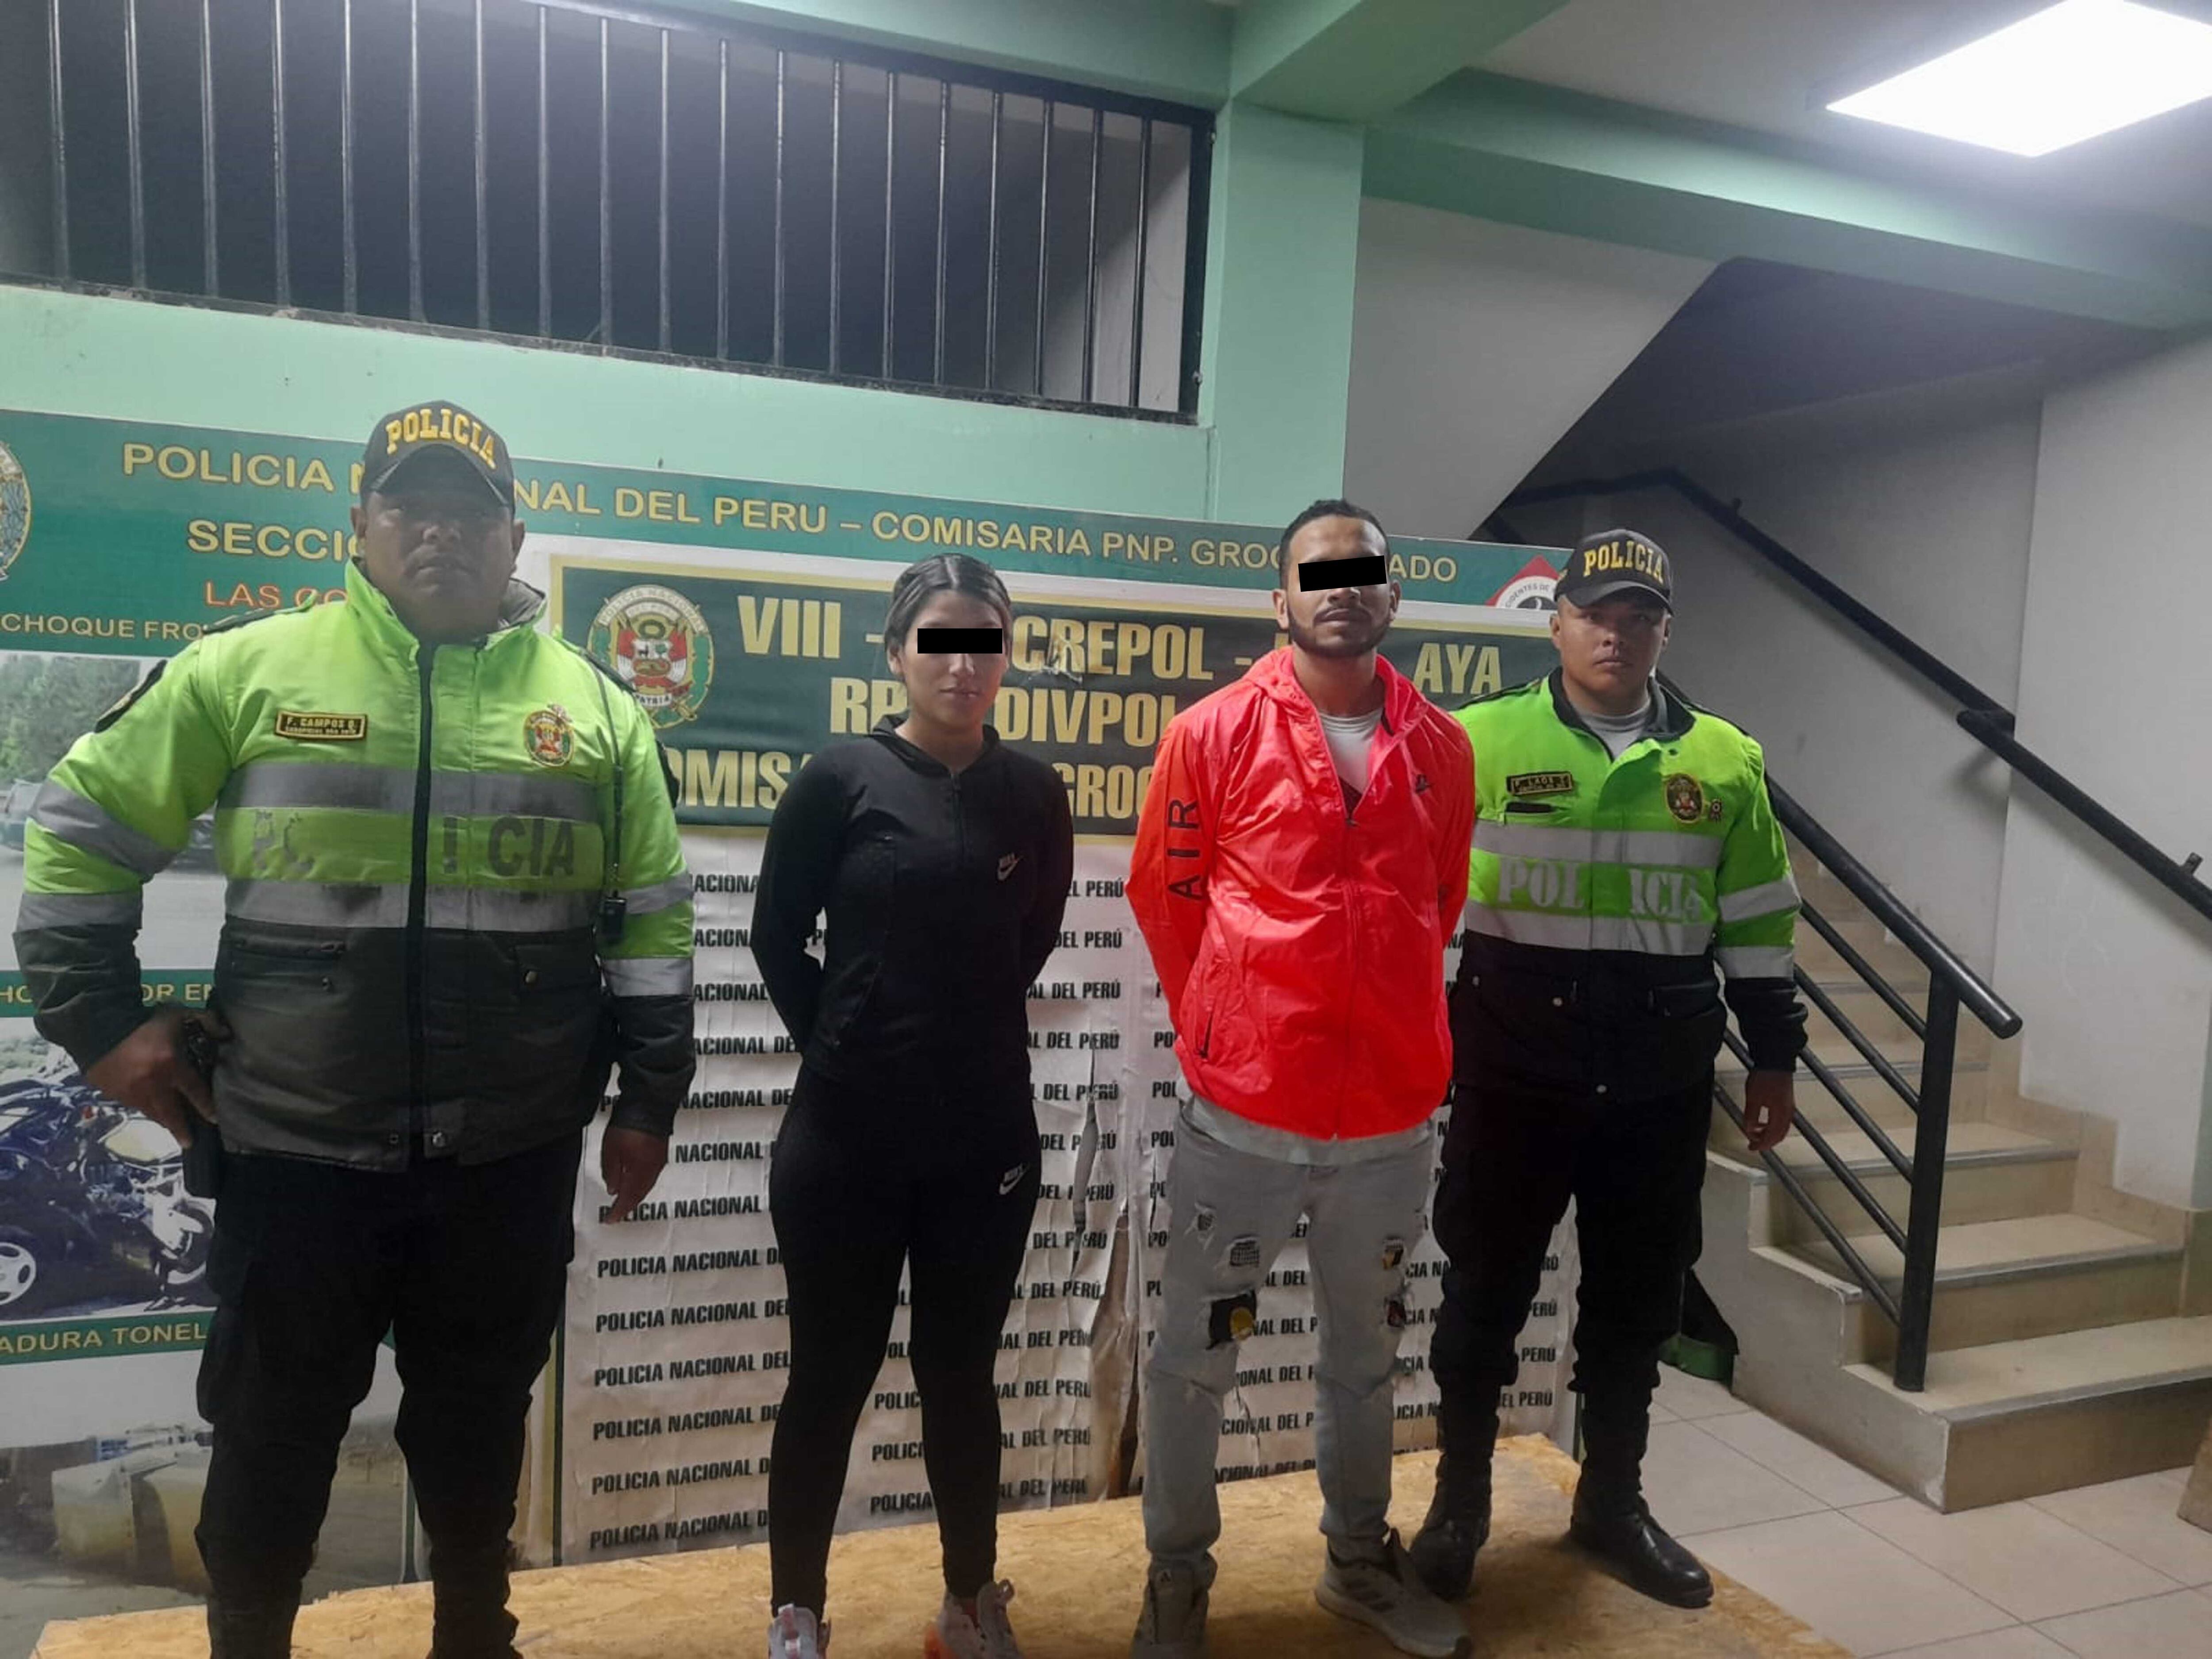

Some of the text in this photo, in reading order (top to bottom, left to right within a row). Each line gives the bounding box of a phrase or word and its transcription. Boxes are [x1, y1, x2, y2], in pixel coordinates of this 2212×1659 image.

[386, 408, 497, 470] POLICIA
[123, 443, 335, 492] POLICIA
[615, 488, 701, 524] DEL
[714, 496, 827, 534] PERU
[872, 511, 1091, 557] COMISARIA
[1102, 533, 1179, 564] PNP.
[1583, 541, 1665, 586] POLICIA
[205, 581, 281, 609] LAS
[1, 613, 135, 638] CHOQUE
[737, 595, 841, 658] VIII
[1166, 799, 1207, 901] AIR
[1086, 877, 1123, 898] PERÚ
[1084, 928, 1122, 948] PERÚ
[1051, 983, 1077, 999] DEL
[1082, 979, 1121, 999] PERÚ
[1046, 1032, 1073, 1049] DEL
[1043, 1083, 1070, 1101] DEL
[676, 1142, 763, 1163] NACIONAL
[674, 1195, 761, 1219] NACIONAL
[1033, 1233, 1058, 1249] DEL
[598, 1256, 666, 1278] POLICIA
[672, 1248, 760, 1273] NACIONAL
[1283, 1270, 1306, 1286] DEL
[1031, 1283, 1056, 1299] DEL
[595, 1310, 664, 1333] POLICIA
[671, 1301, 758, 1326] NACIONAL
[1281, 1317, 1304, 1334] DEL
[1027, 1331, 1054, 1348] DEL
[594, 1363, 663, 1387] POLICIA
[669, 1354, 756, 1379] NACIONAL
[1279, 1367, 1301, 1382] DEL
[1024, 1379, 1049, 1398] DEL
[593, 1417, 662, 1440] POLICIA
[668, 1407, 755, 1433] NACIONAL
[1277, 1414, 1299, 1431] DEL
[1022, 1429, 1047, 1448] DEL
[591, 1471, 660, 1495] POLICIA
[666, 1459, 753, 1486] NACIONAL
[1019, 1479, 1045, 1497] DEL
[590, 1524, 659, 1550] POLICIA
[664, 1511, 751, 1540] NACIONAL
